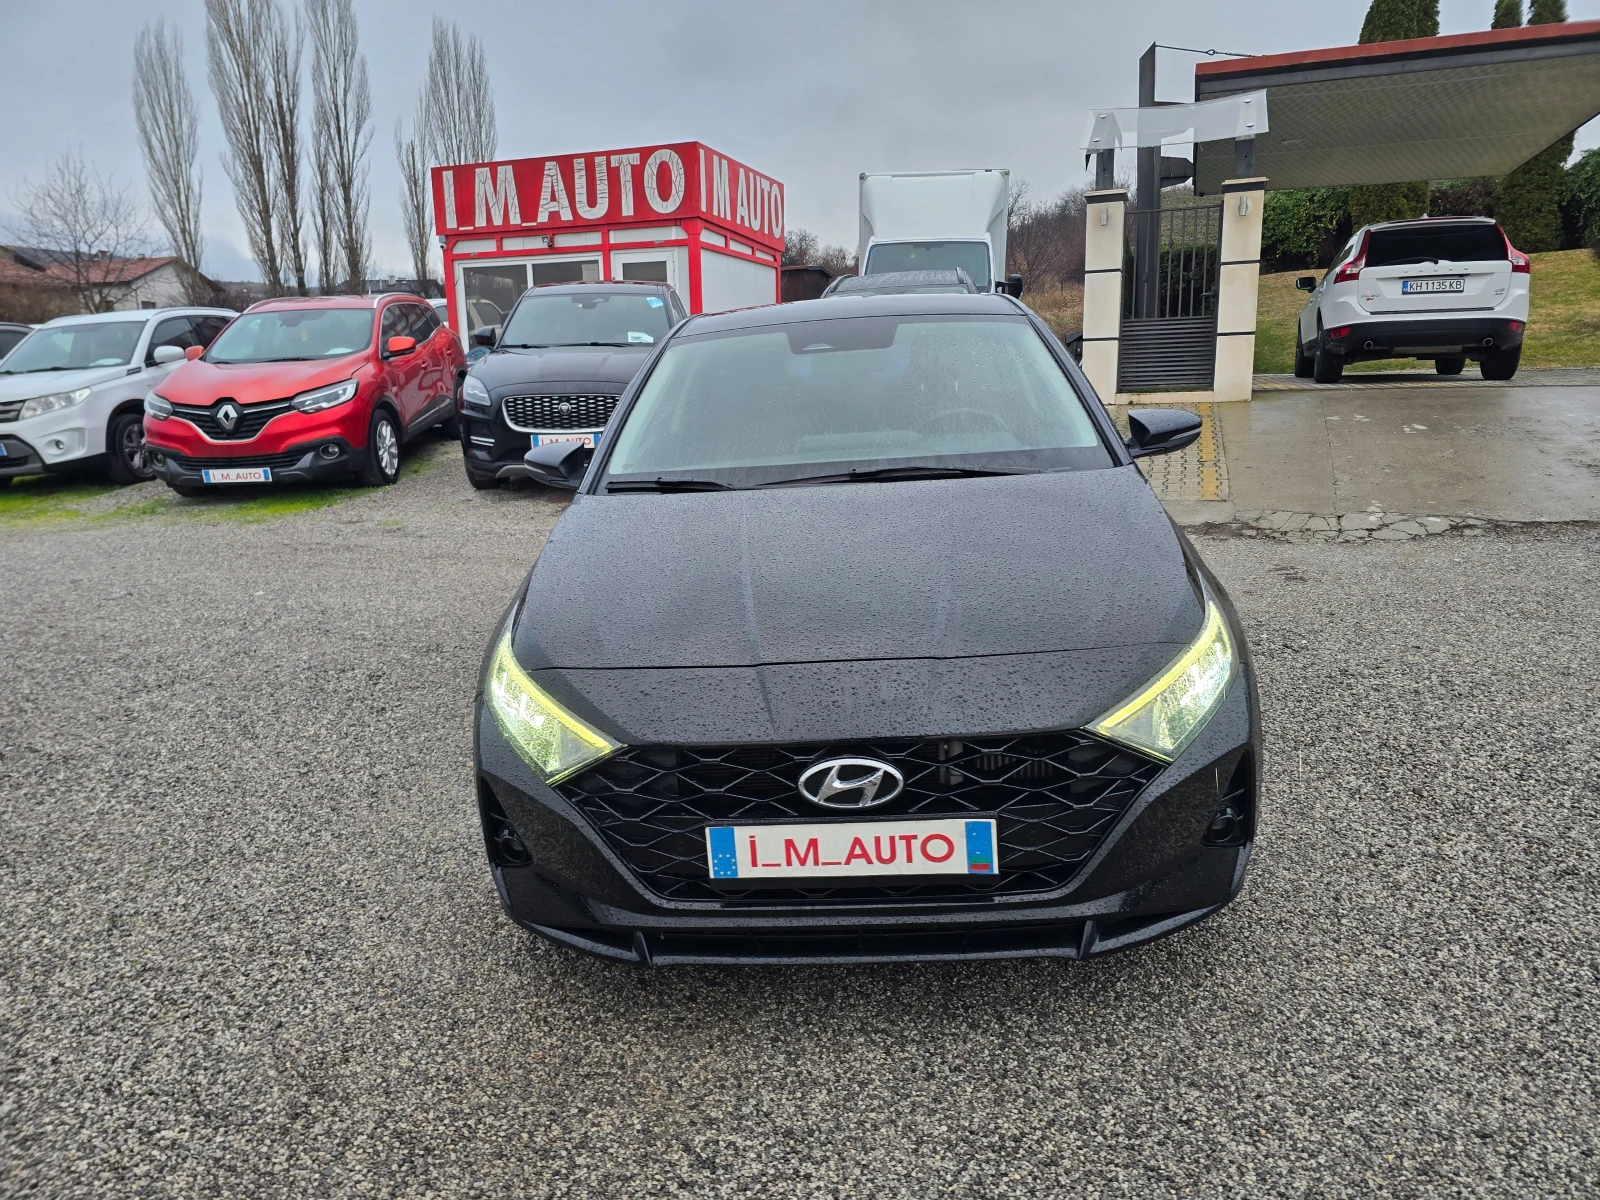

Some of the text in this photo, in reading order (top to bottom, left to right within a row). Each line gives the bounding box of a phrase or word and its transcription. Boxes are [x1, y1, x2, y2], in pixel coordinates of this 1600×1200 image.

[442, 149, 685, 231] I_M_AUTO
[712, 154, 731, 221] M
[736, 167, 782, 239] AUTO
[1409, 280, 1422, 291] KH
[1425, 280, 1447, 290] 1135
[1449, 280, 1462, 290] KB
